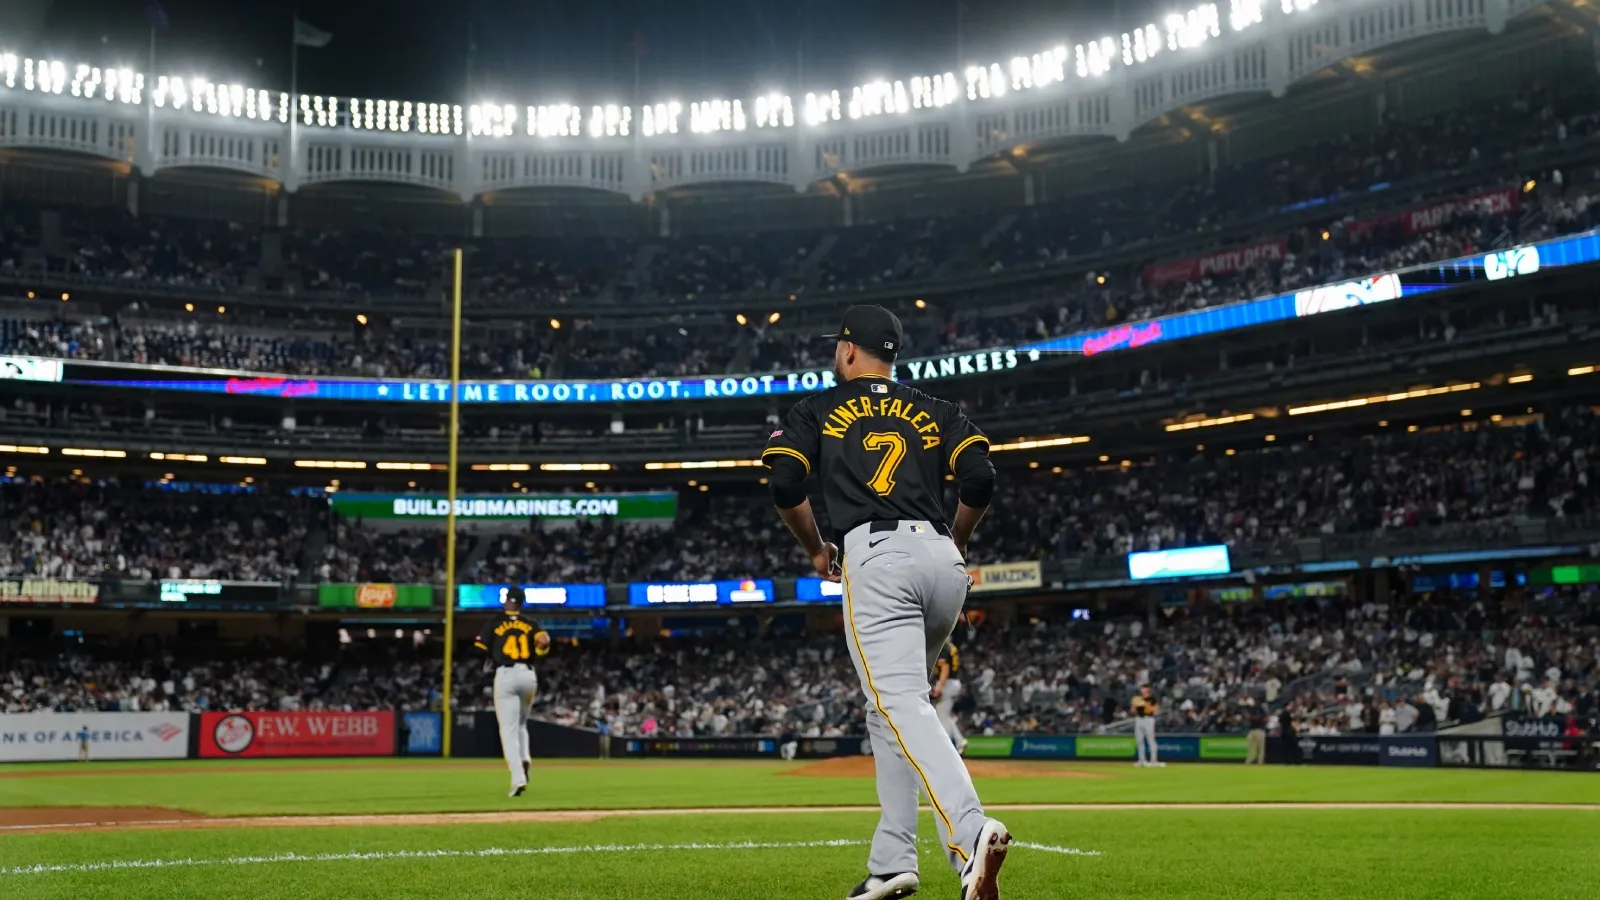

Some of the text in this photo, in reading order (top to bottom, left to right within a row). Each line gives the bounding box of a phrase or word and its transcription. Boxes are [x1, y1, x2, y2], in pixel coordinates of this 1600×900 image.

[403, 382, 449, 400] LET
[464, 384, 500, 401] ME
[705, 375, 774, 397] ROOT
[788, 371, 837, 391] FOR
[908, 349, 1018, 380] YANKEES
[822, 396, 941, 450] KINER-FALEFA
[862, 431, 907, 497] 7
[393, 499, 619, 516] BUILDSUBMARINES.COM
[502, 633, 531, 660] 41
[34, 731, 57, 743] OF
[257, 715, 378, 737] F.W. WEBB
